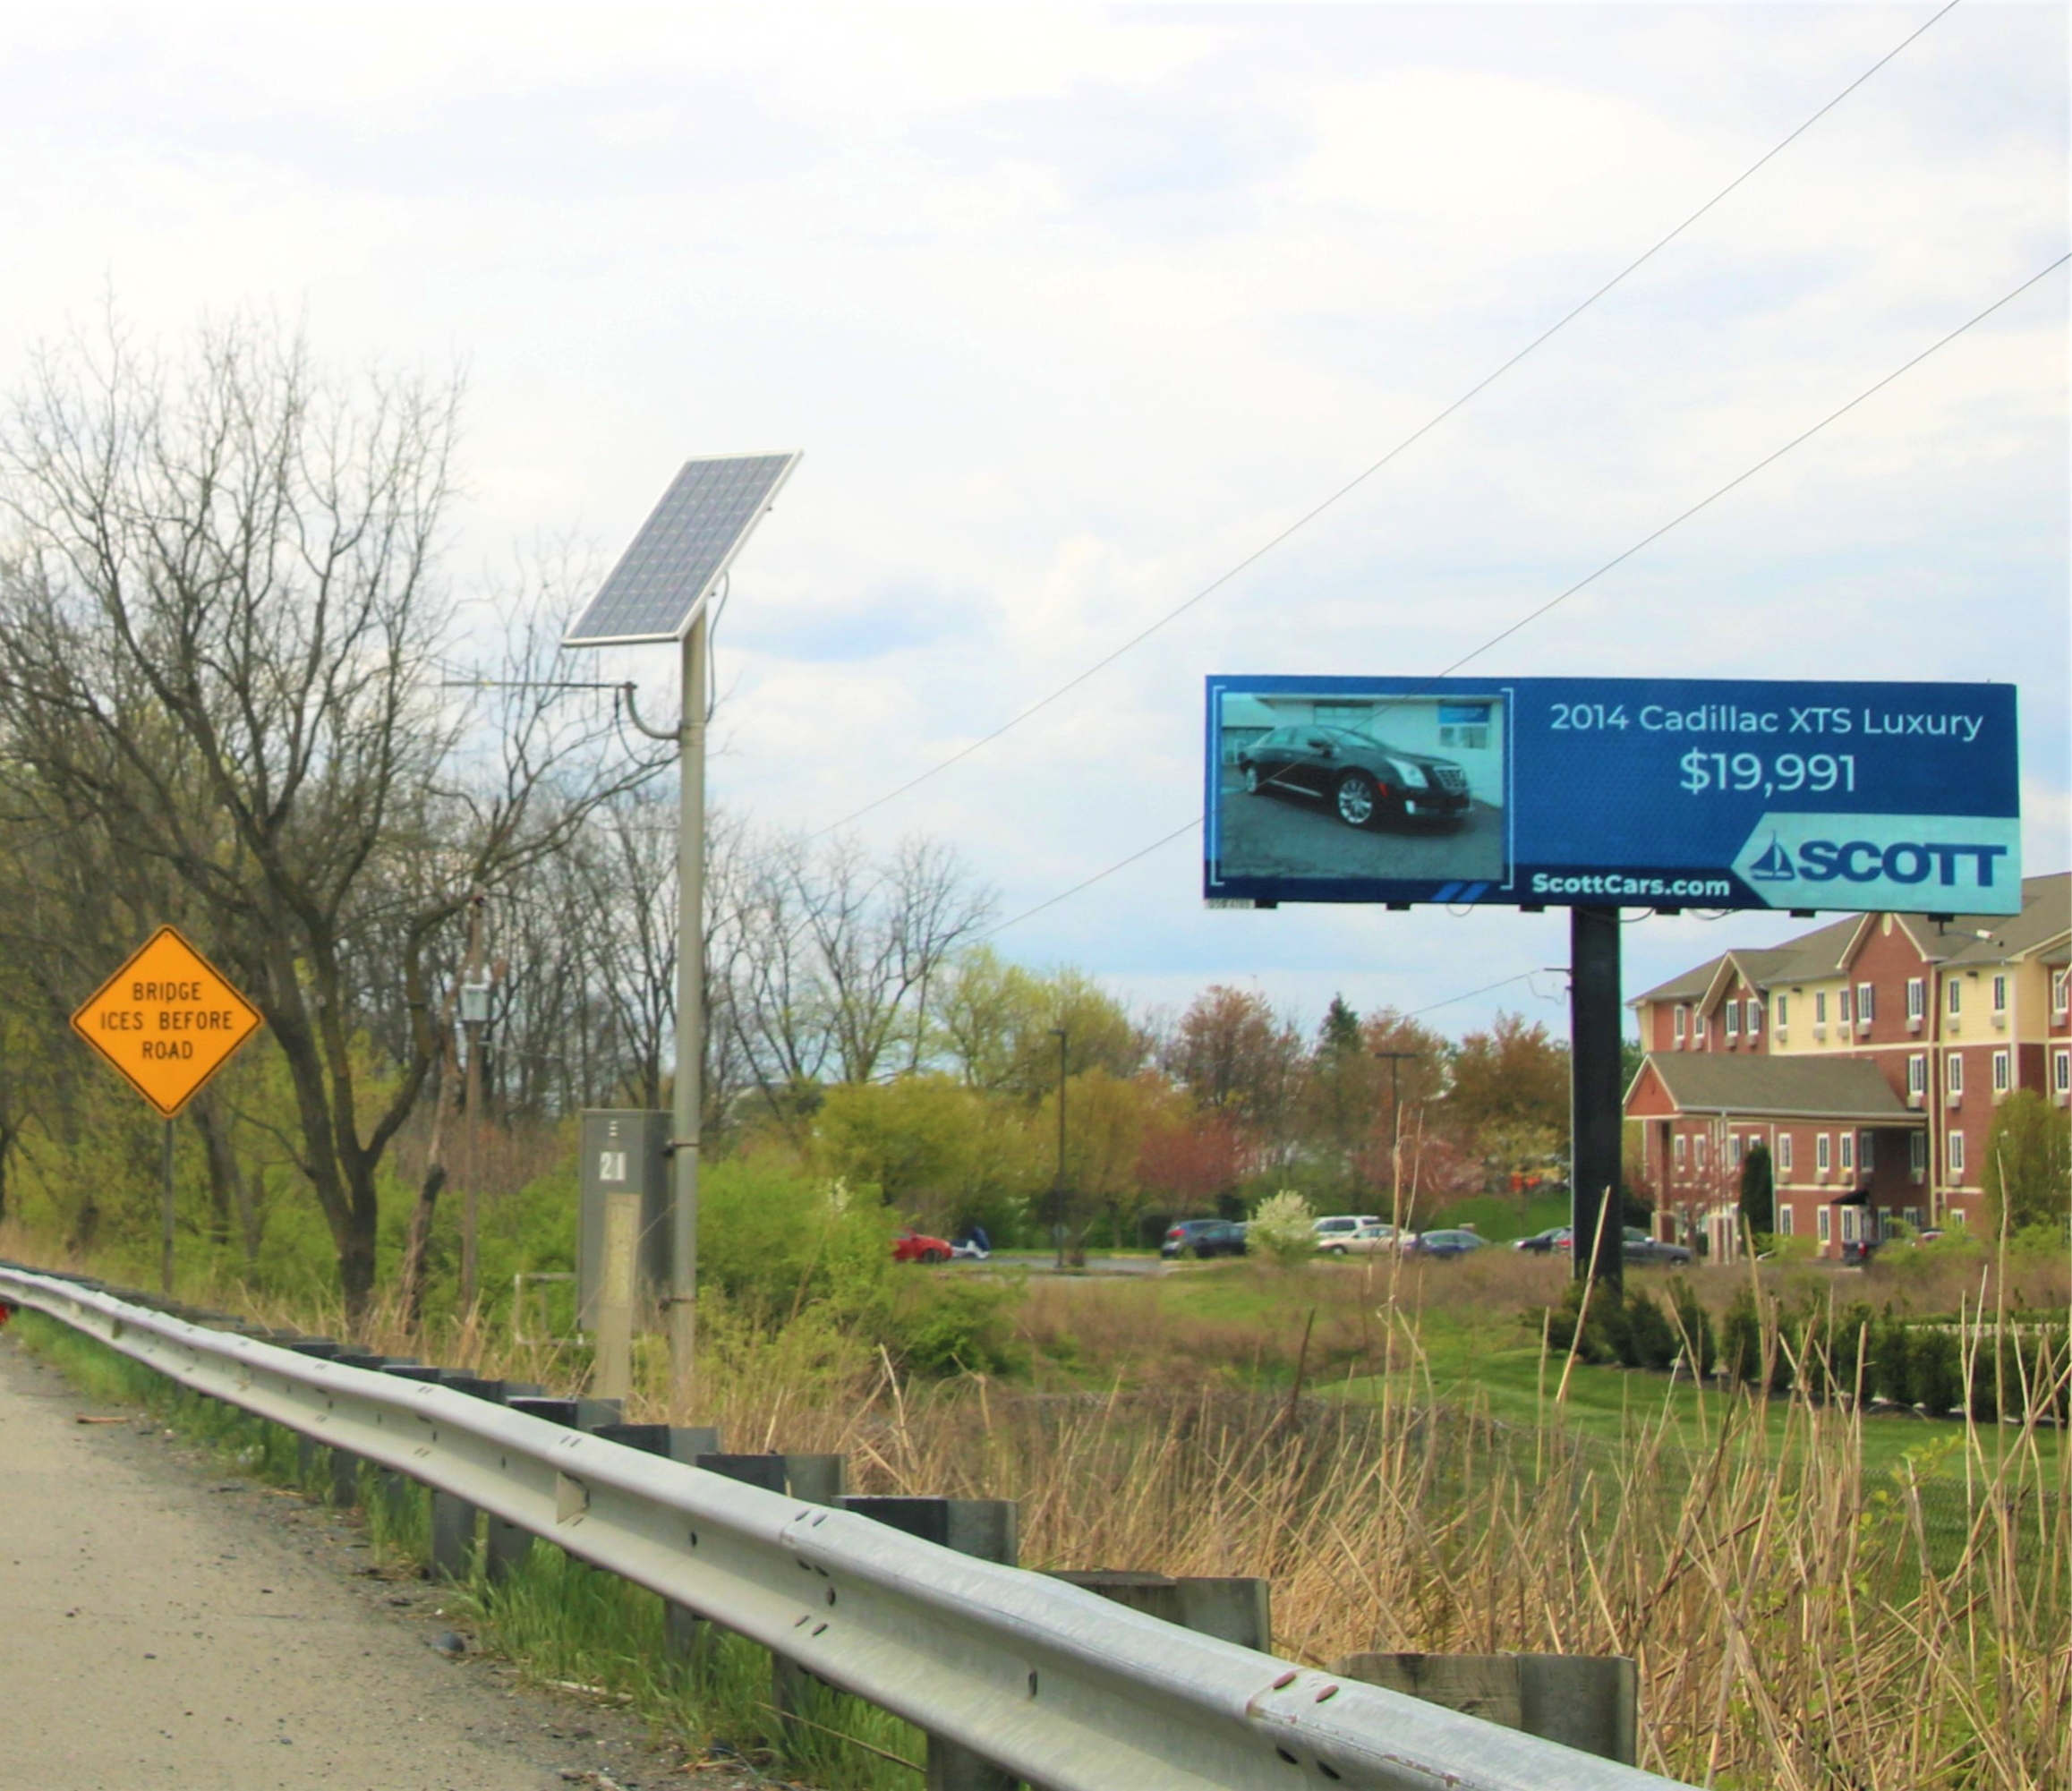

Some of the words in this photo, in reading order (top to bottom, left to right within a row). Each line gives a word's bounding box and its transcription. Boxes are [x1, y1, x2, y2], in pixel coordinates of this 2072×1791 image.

[1550, 704, 1629, 730] 2014
[1639, 705, 1778, 733] Cadillac
[1788, 707, 1853, 734] XTS
[1863, 709, 1983, 742] Luxury
[1679, 746, 1856, 797] $19,991
[1798, 840, 2008, 887] SCOTT
[1531, 873, 1730, 896] ScottCars.com
[132, 982, 201, 1002] BRIDGE
[100, 1011, 143, 1030] ICES
[159, 1011, 233, 1030] BEFORE
[141, 1041, 193, 1060] ROAD
[600, 1152, 626, 1181] 21
